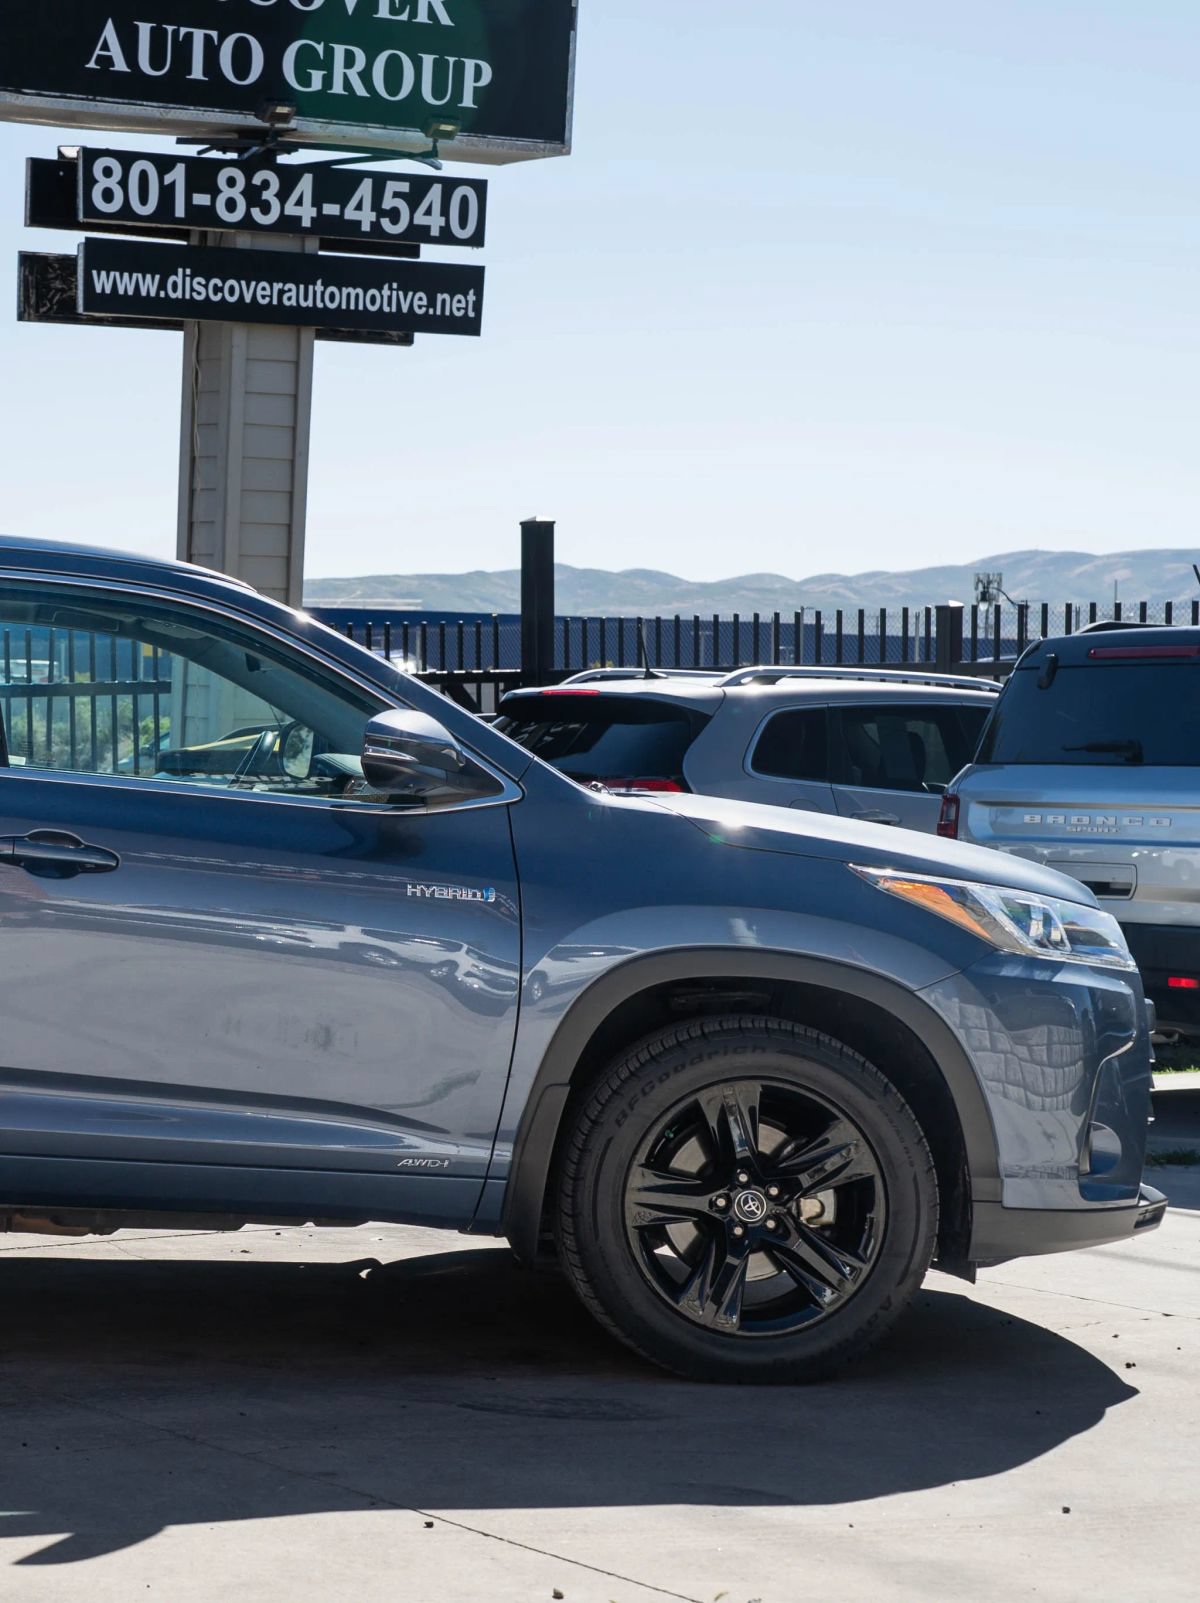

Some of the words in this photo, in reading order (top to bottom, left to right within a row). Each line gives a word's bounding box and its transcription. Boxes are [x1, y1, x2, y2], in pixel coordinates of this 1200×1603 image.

[85, 18, 265, 86] AUTO
[282, 39, 493, 109] GROUP
[91, 156, 479, 240] 801-834-4540
[91, 267, 476, 319] www.discoverautomotive.net
[1023, 814, 1172, 827] BRONCO
[406, 882, 482, 902] HYBRID
[613, 1043, 768, 1129] BFGoodrich
